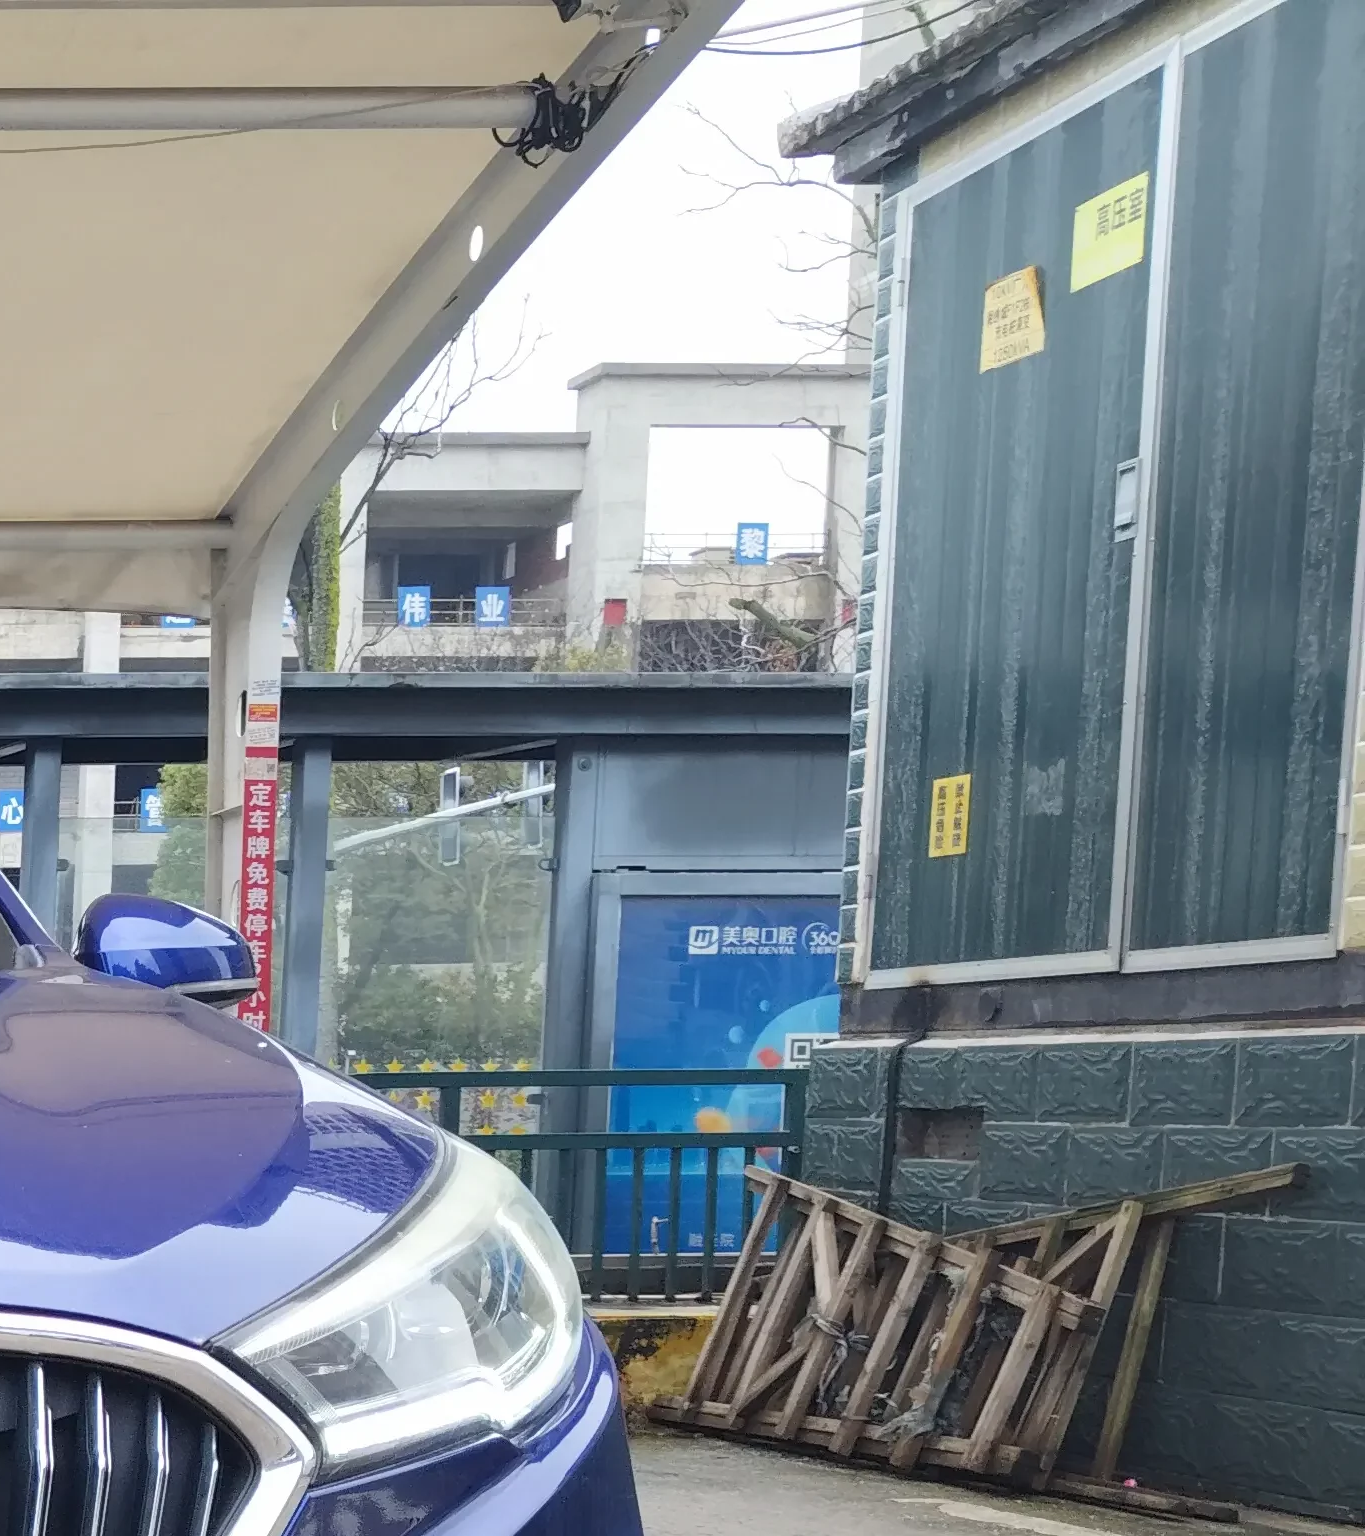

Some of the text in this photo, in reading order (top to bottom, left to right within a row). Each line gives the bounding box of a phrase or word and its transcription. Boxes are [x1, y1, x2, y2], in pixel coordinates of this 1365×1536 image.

[740, 527, 766, 559] 黎
[402, 591, 429, 624] 伟
[480, 592, 505, 623] 业
[0, 797, 24, 825] 心
[722, 926, 798, 946] 美奥口腔
